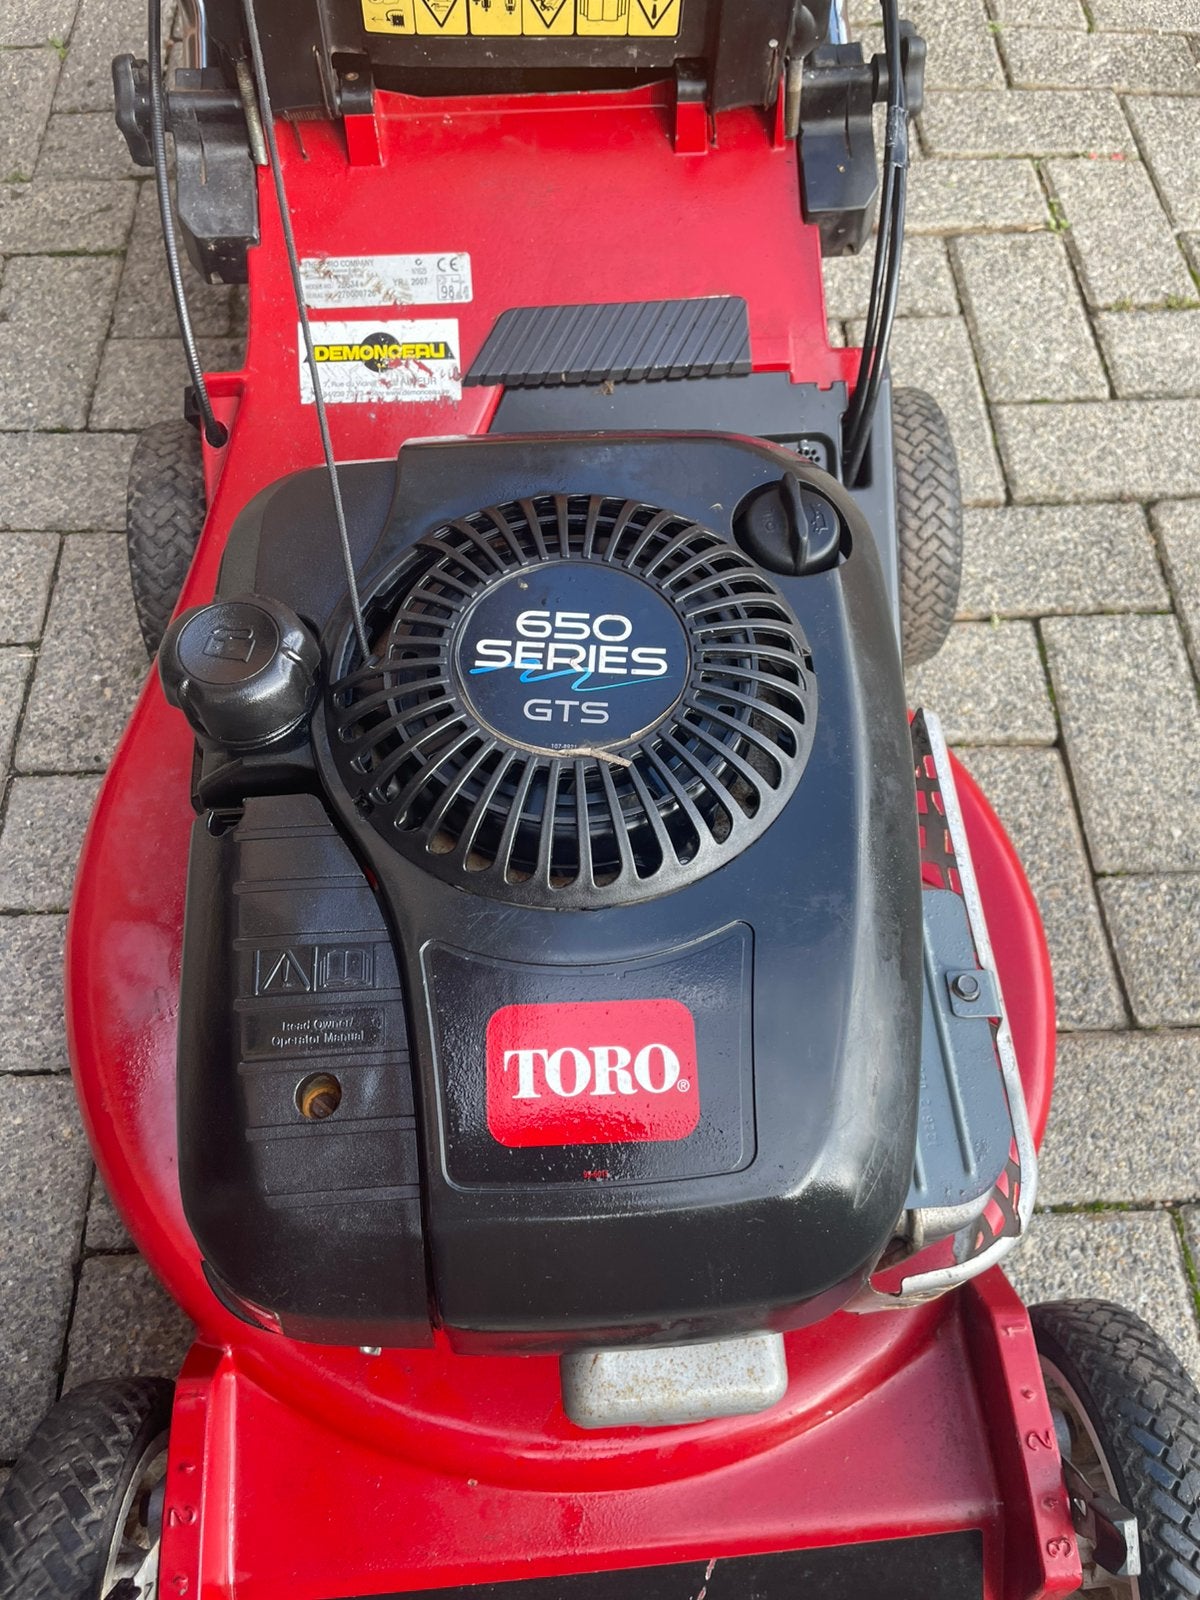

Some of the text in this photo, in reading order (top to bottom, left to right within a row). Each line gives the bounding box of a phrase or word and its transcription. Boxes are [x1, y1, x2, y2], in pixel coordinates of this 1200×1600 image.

[313, 342, 446, 362] DEMONCEAU
[515, 610, 633, 642] 650
[474, 638, 668, 676] SERIES
[523, 698, 610, 724] GTS
[282, 1020, 311, 1031] Read
[271, 1030, 365, 1048] Operator Manual
[503, 1043, 681, 1099] TORO
[1026, 1429, 1054, 1453] 2
[168, 1505, 198, 1528] 2
[1046, 1535, 1074, 1559] 3
